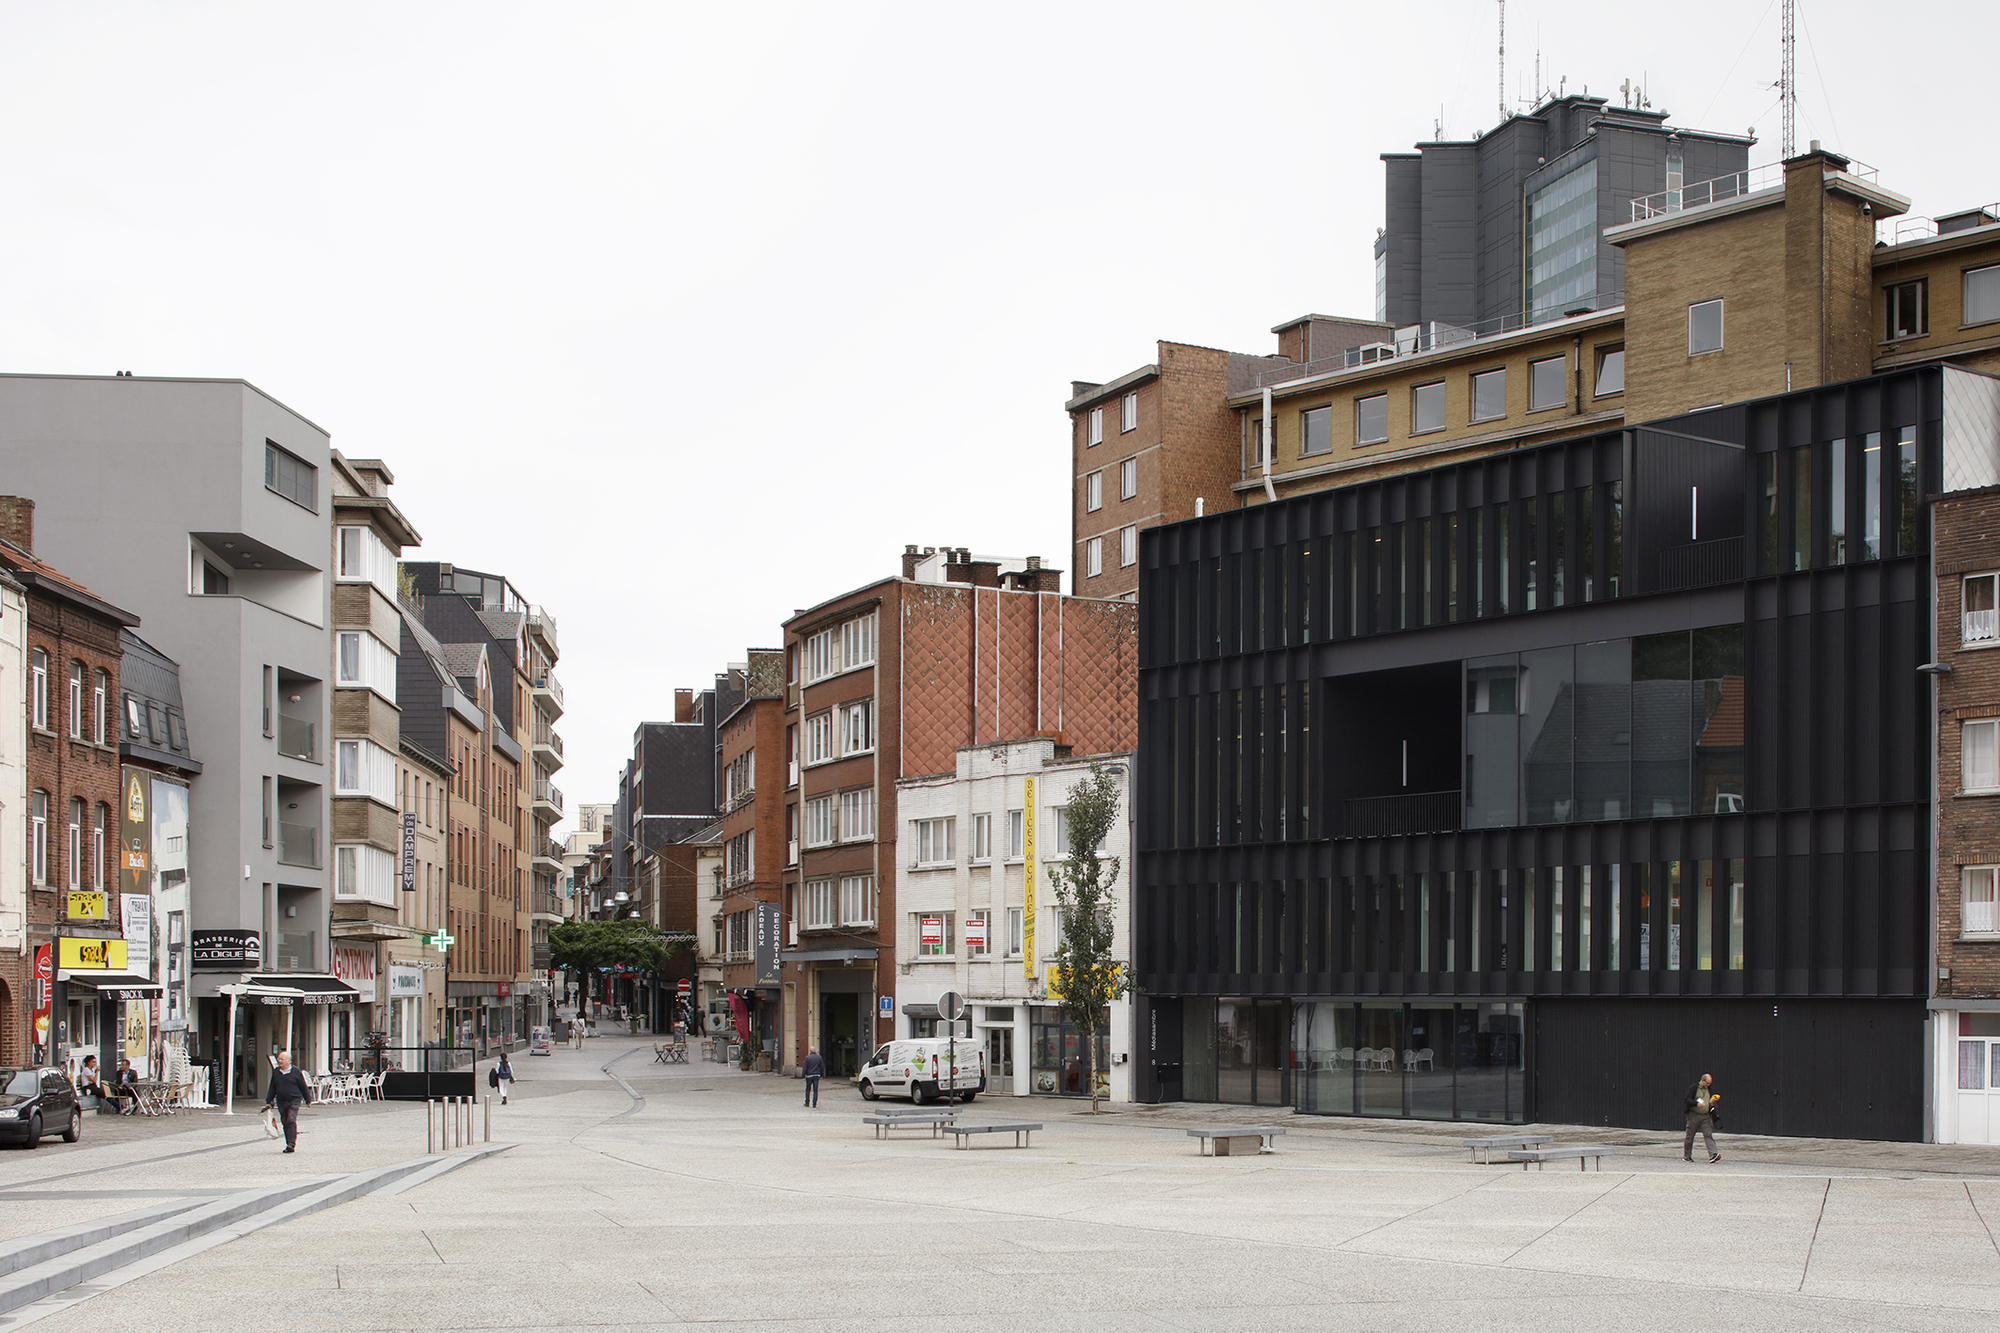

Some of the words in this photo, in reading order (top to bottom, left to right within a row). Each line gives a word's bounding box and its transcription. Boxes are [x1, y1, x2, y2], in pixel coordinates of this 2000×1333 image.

[128, 853, 145, 868] Bush
[404, 827, 415, 889] DAMPREMY
[193, 936, 244, 947] BRASSERIE
[210, 950, 244, 958] DIGUE
[119, 989, 137, 999] SNACK
